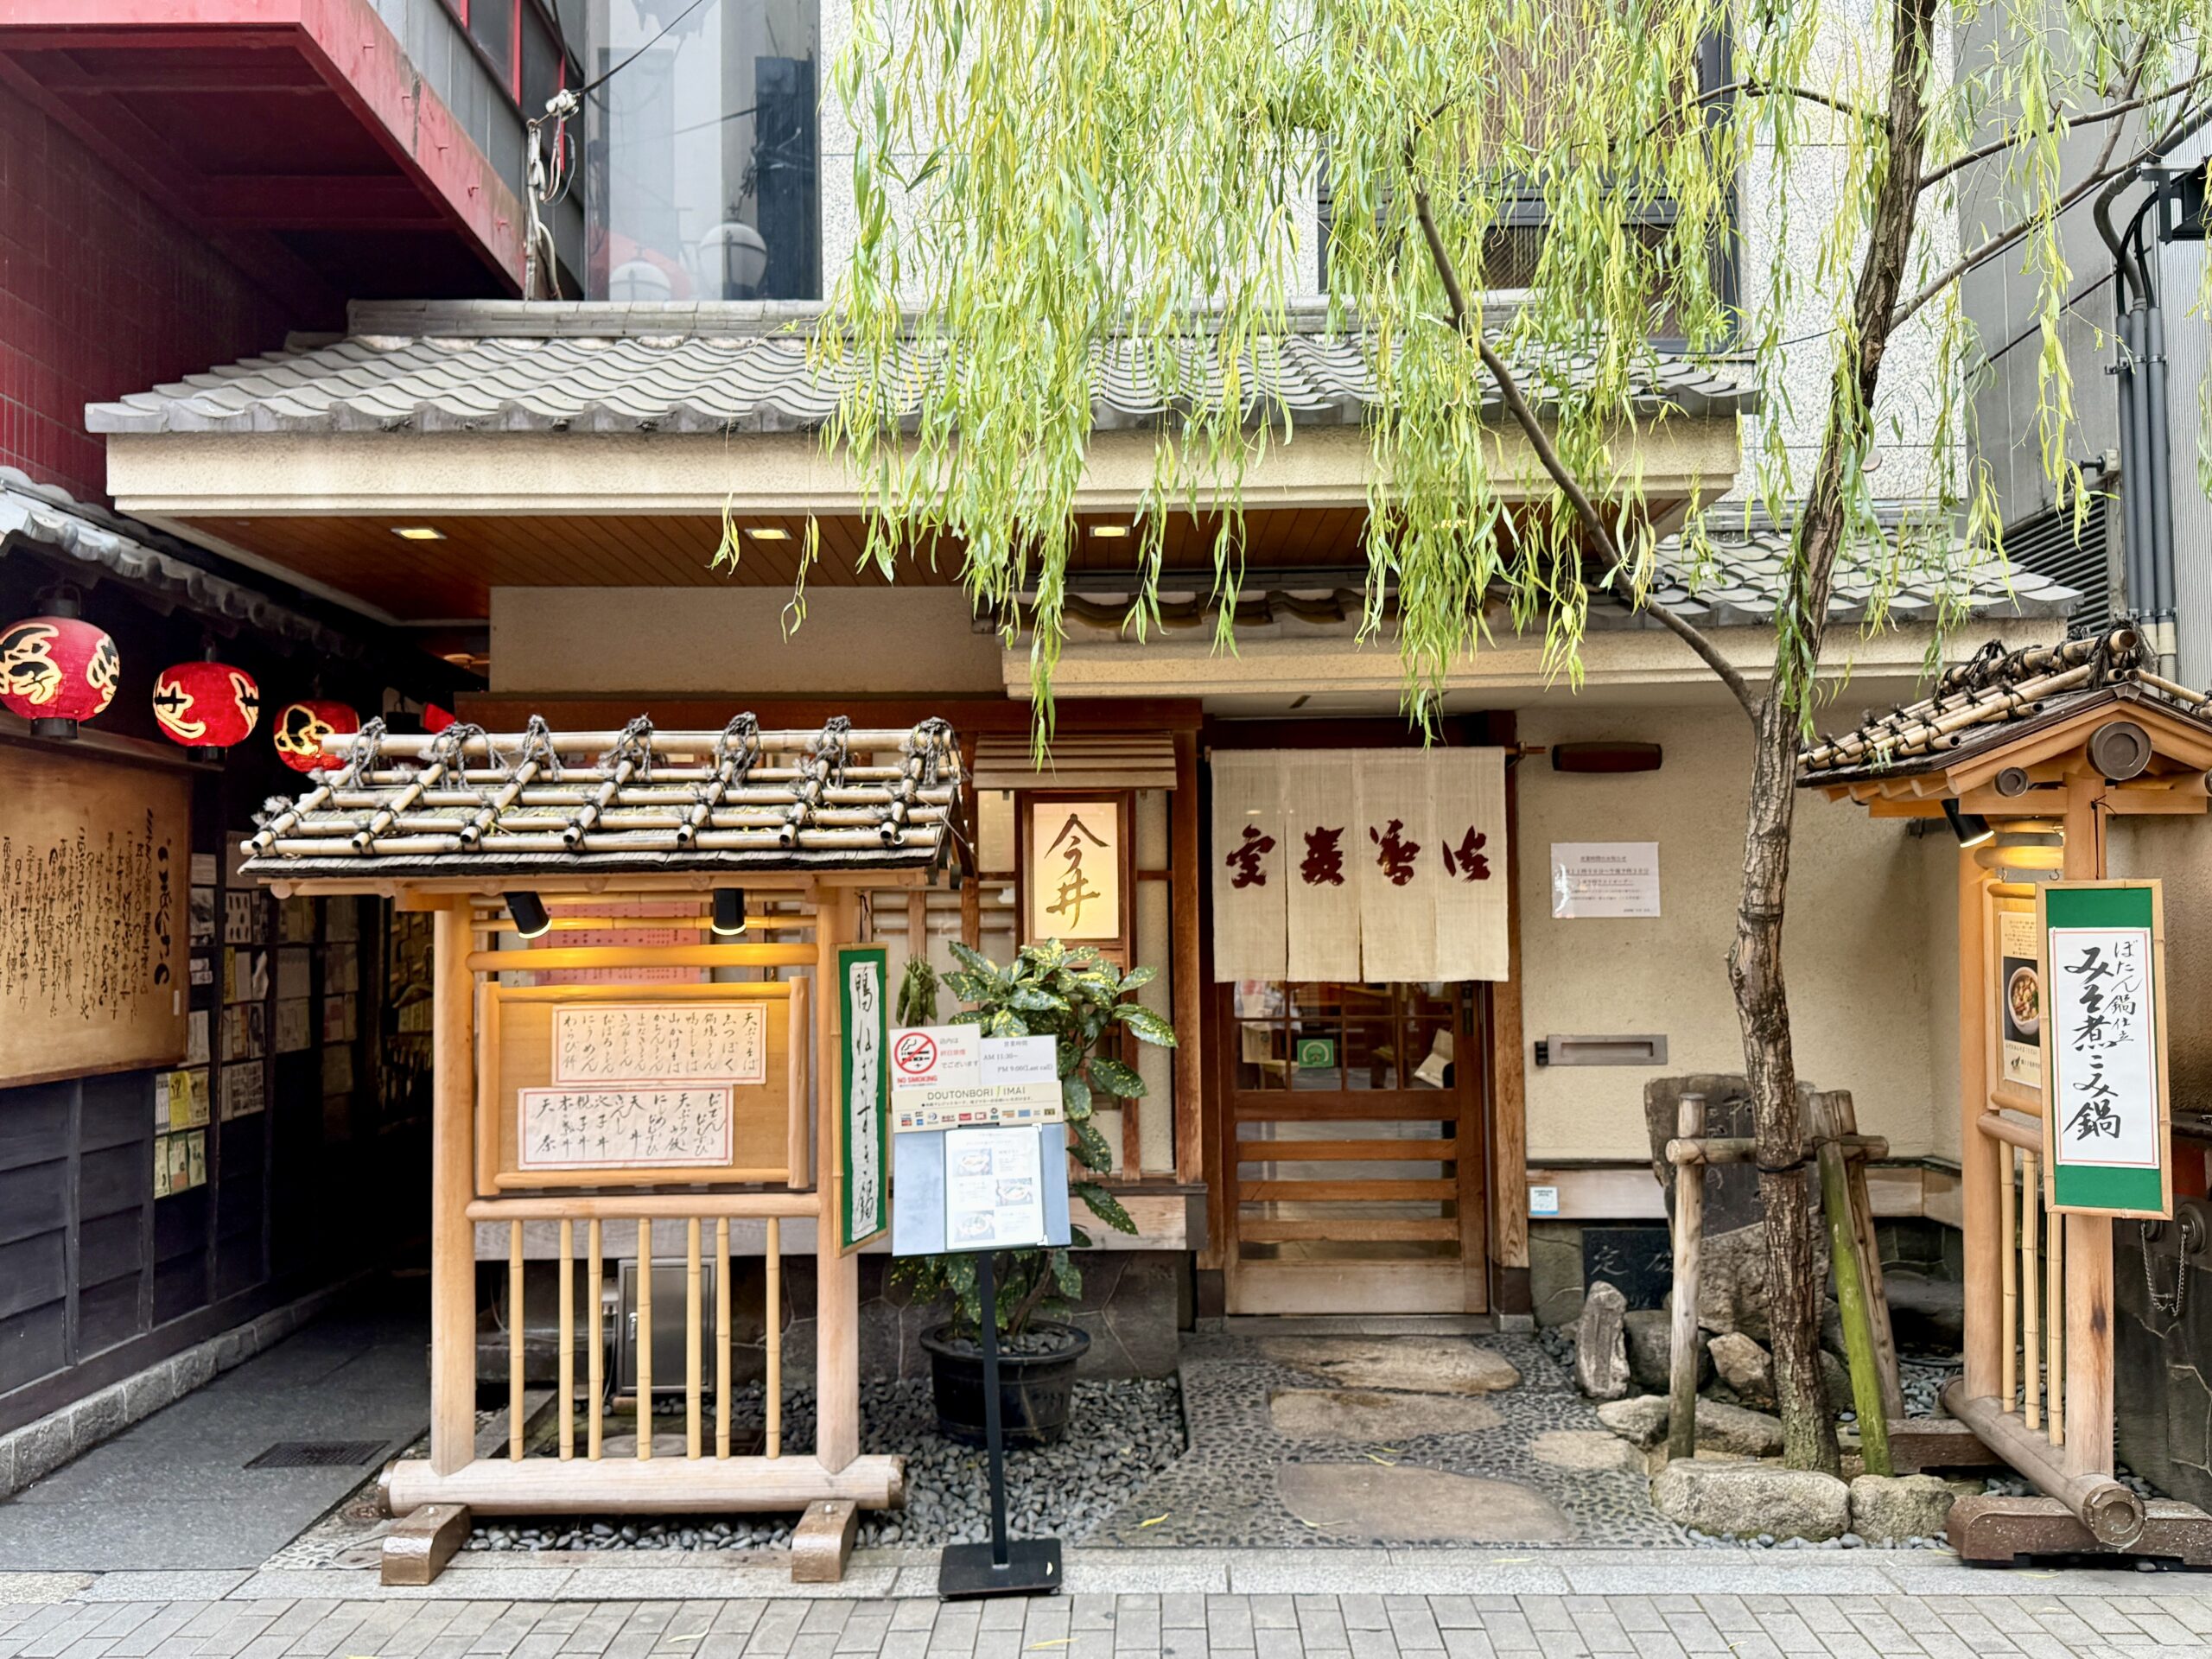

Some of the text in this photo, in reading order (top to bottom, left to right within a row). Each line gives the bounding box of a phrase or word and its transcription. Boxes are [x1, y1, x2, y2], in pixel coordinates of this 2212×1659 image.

[1044, 813, 1111, 931] 今井
[927, 1088, 994, 1100] DOUTONBORI
[1003, 1086, 1027, 1096] IMAI
